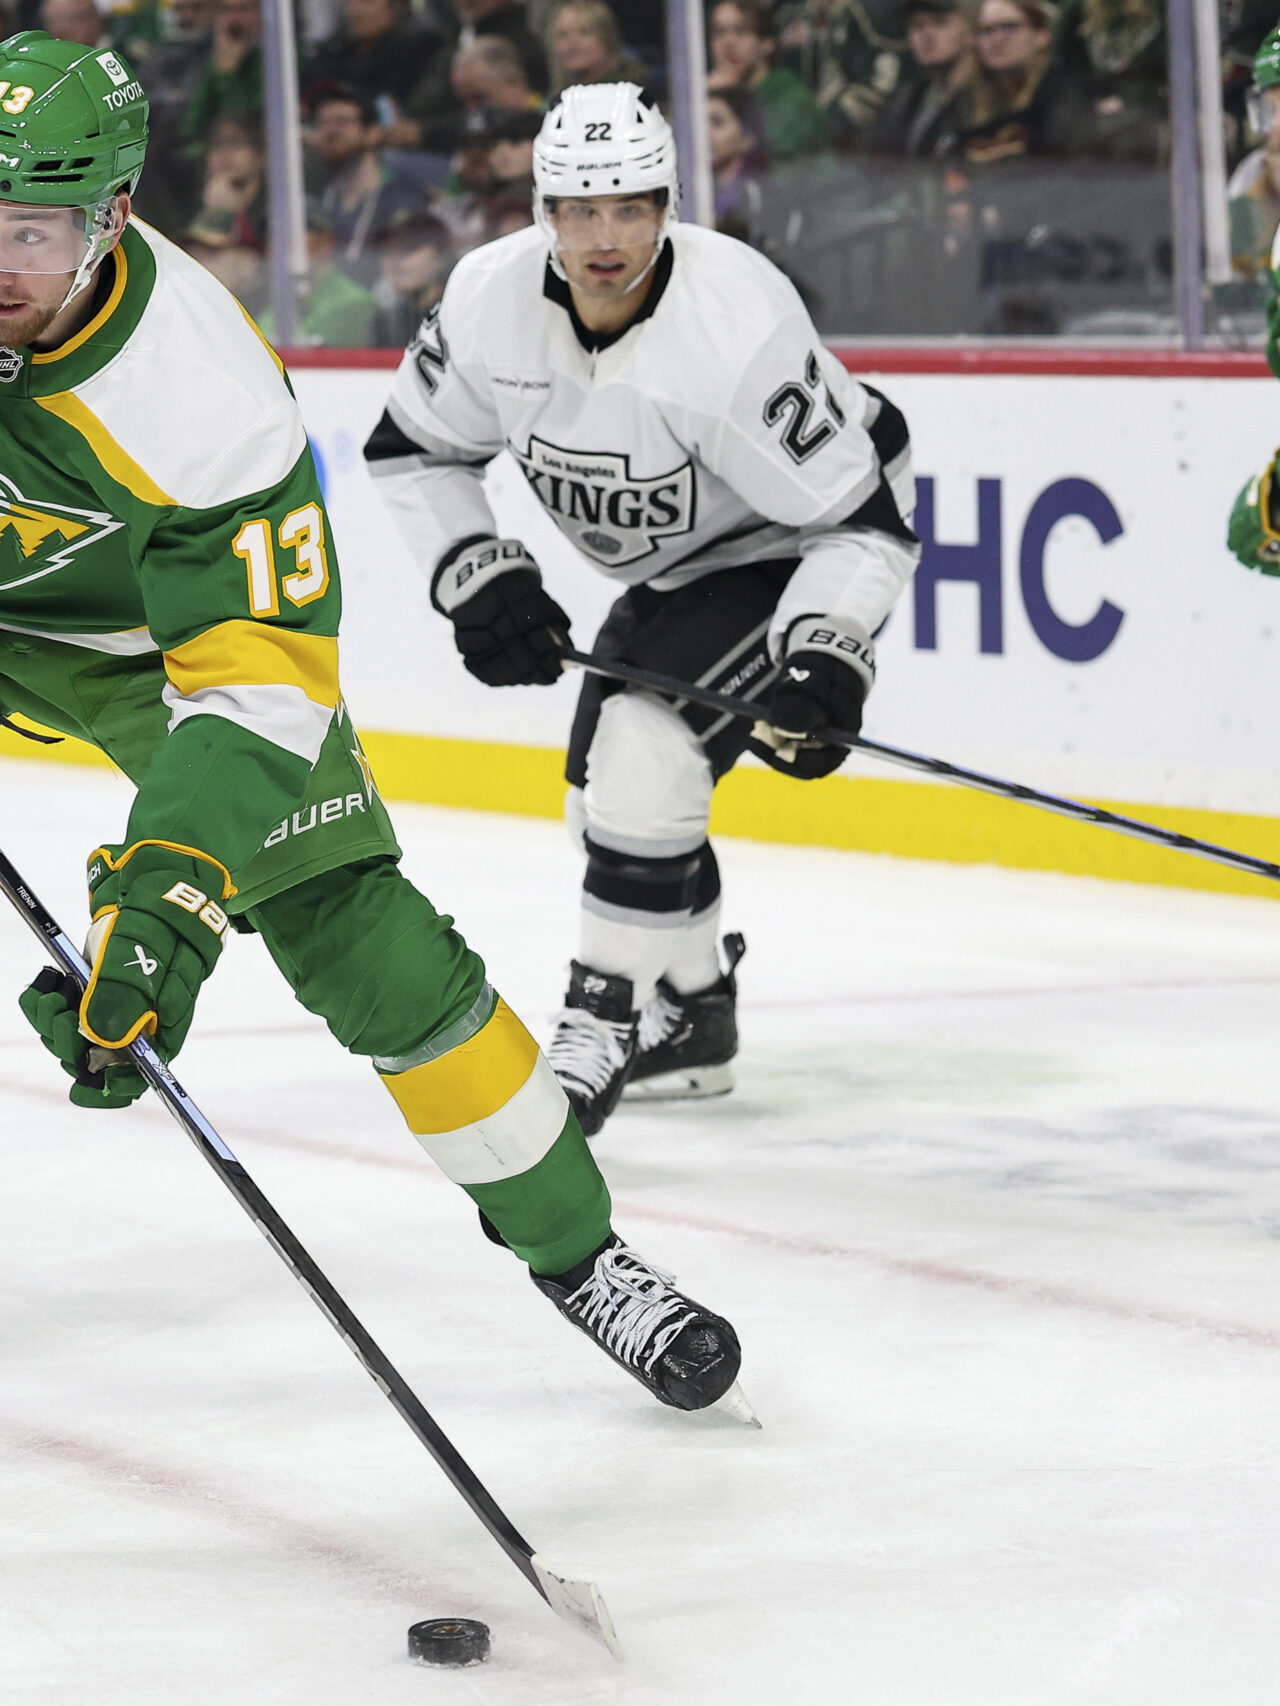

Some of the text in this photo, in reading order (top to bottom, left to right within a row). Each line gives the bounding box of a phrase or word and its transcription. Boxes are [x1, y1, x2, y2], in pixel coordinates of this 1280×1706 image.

[102, 80, 146, 112] TOYOTA
[584, 122, 612, 142] 22
[541, 453, 616, 479] Los Angeles
[232, 501, 330, 618] 13
[263, 792, 366, 849] AUER
[16, 885, 37, 909] TRENIN
